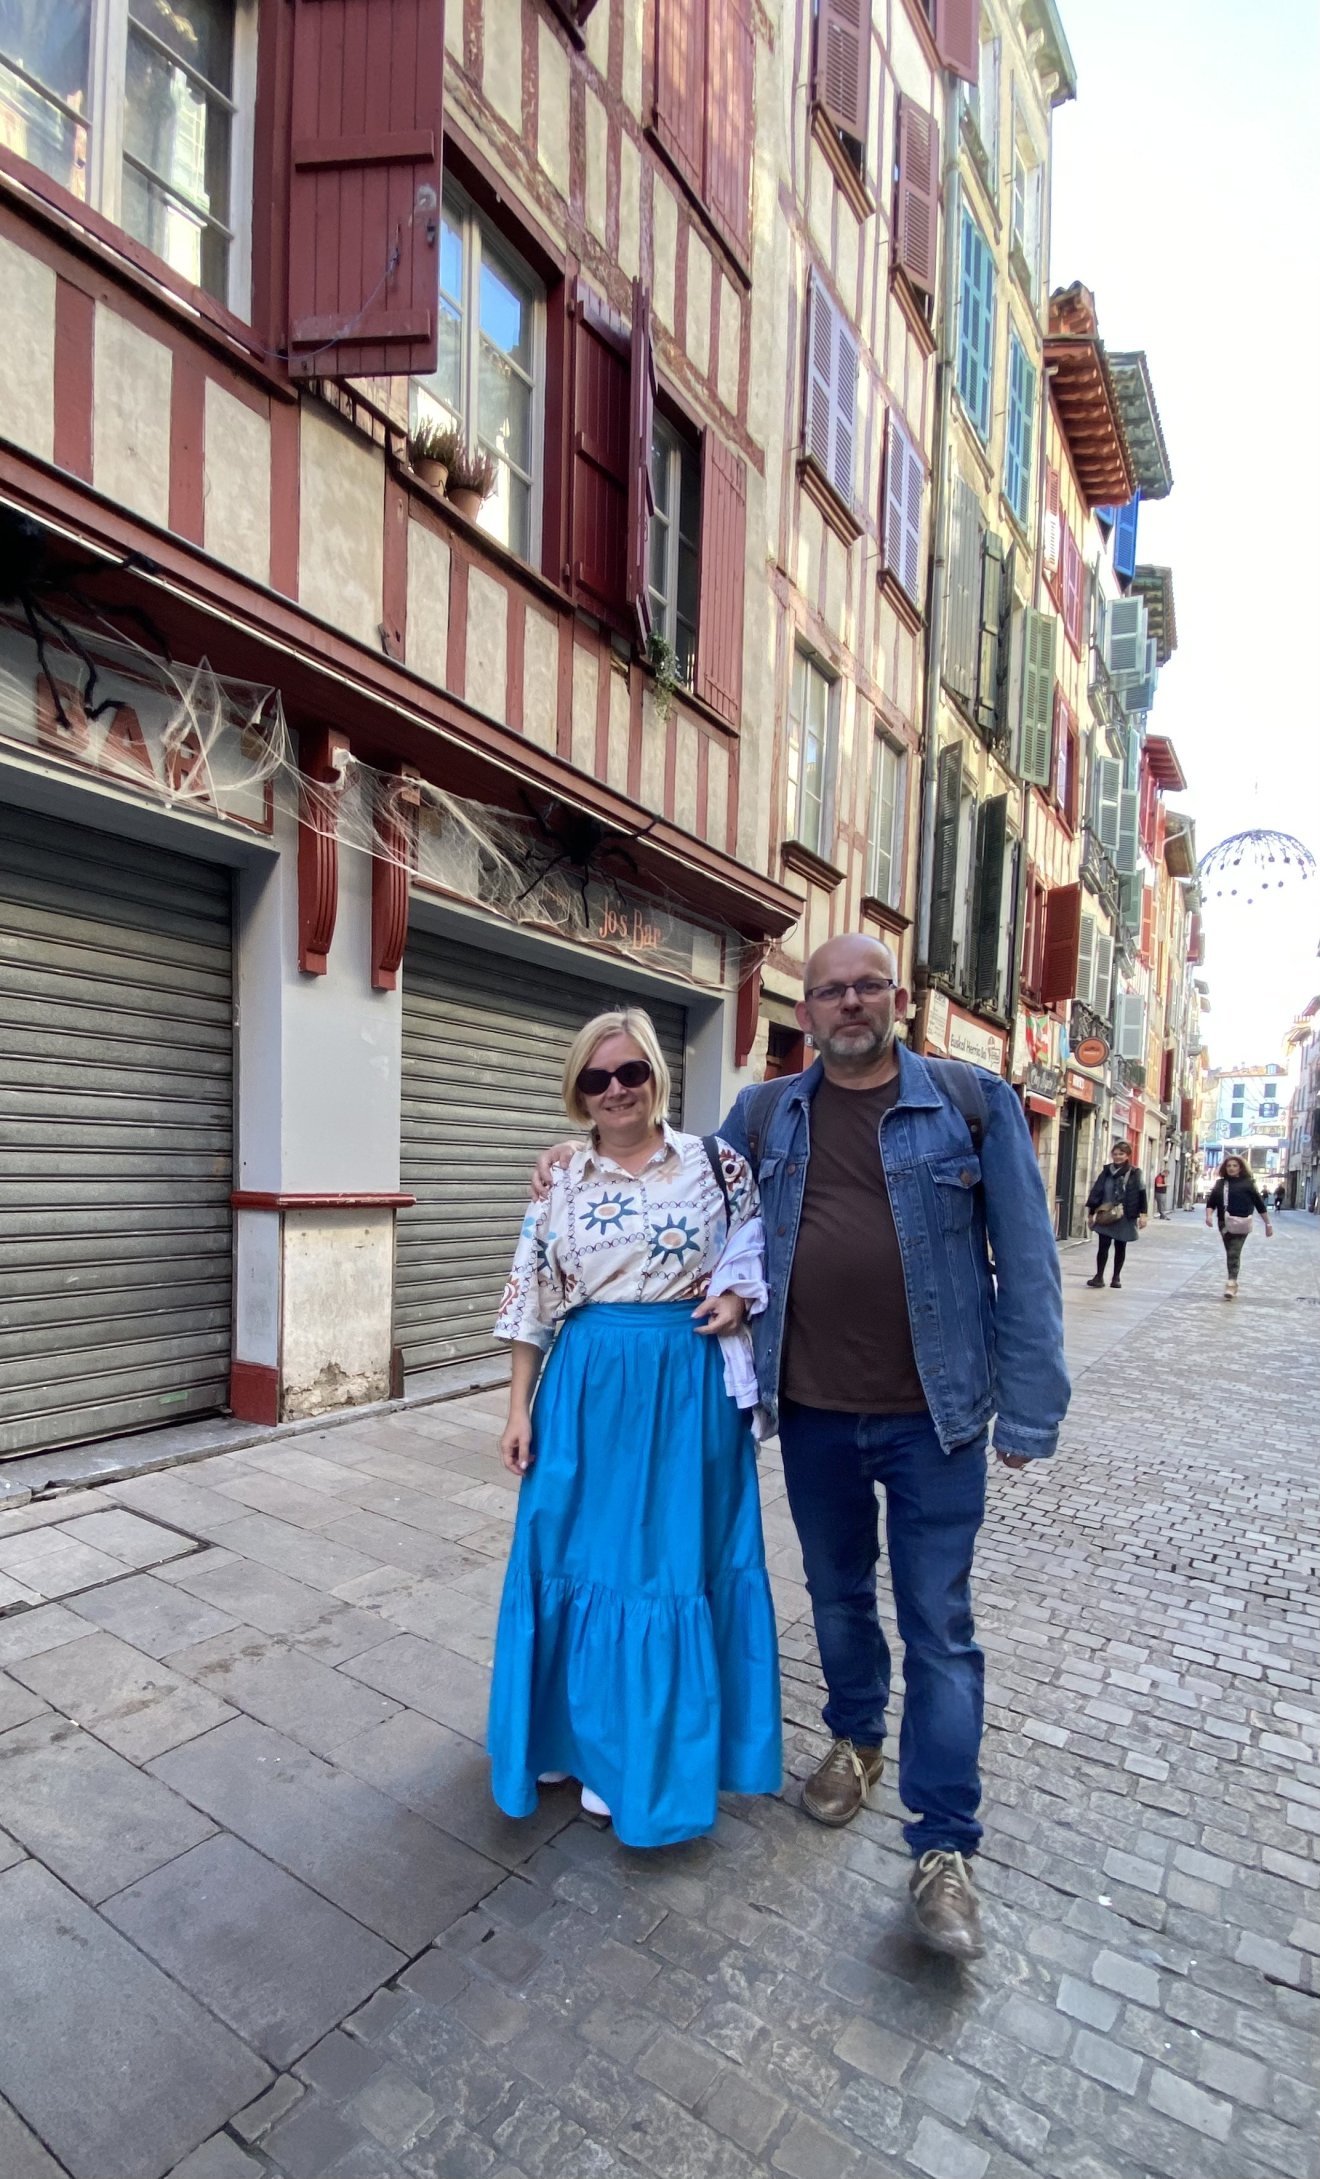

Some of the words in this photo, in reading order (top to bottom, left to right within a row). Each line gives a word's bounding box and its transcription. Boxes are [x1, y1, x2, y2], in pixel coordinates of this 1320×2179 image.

[36, 672, 211, 802] BAR
[600, 896, 628, 938] Jo's
[633, 908, 661, 950] Bar
